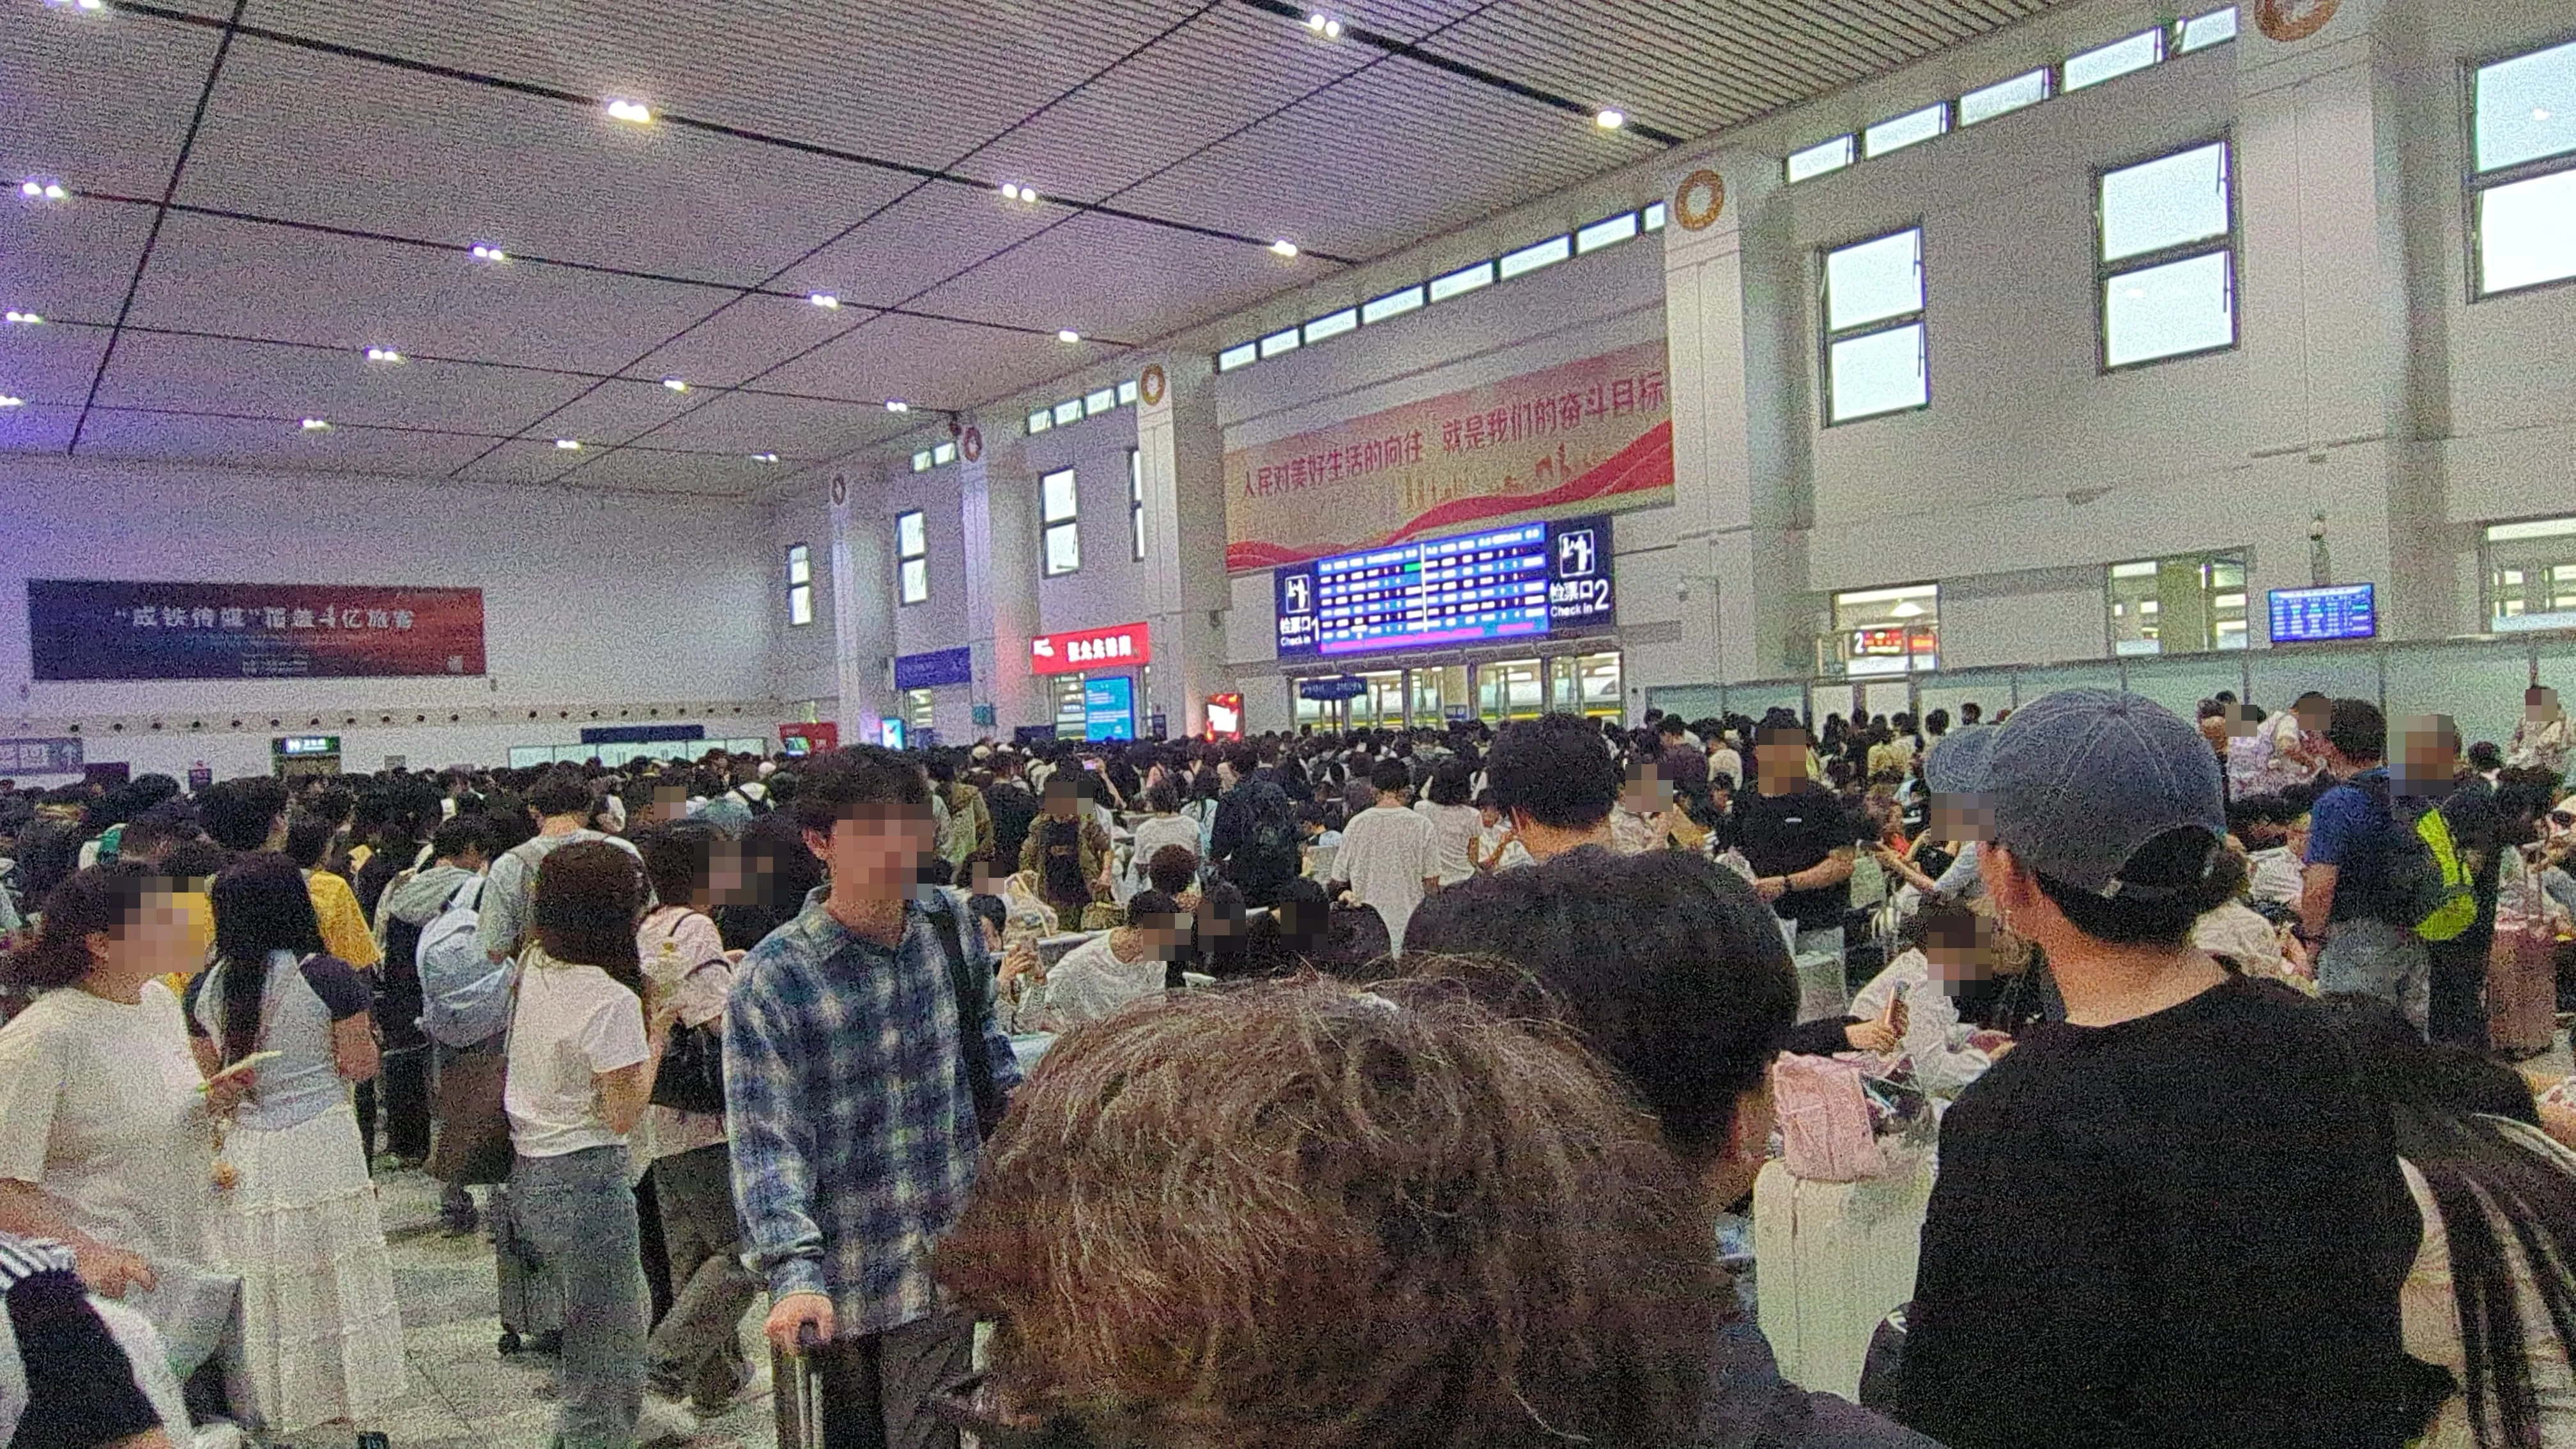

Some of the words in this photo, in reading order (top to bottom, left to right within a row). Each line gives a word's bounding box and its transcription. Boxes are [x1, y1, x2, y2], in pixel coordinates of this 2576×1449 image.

[1243, 429, 1423, 498] 人民对美好生活的向往
[1441, 371, 1665, 453] 就是我们的奋斗目标
[1550, 580, 1593, 603] 检票口
[1594, 579, 1609, 611] 2
[1550, 604, 1582, 617] Check
[1311, 615, 1320, 641] 1
[1854, 632, 1864, 654] 2
